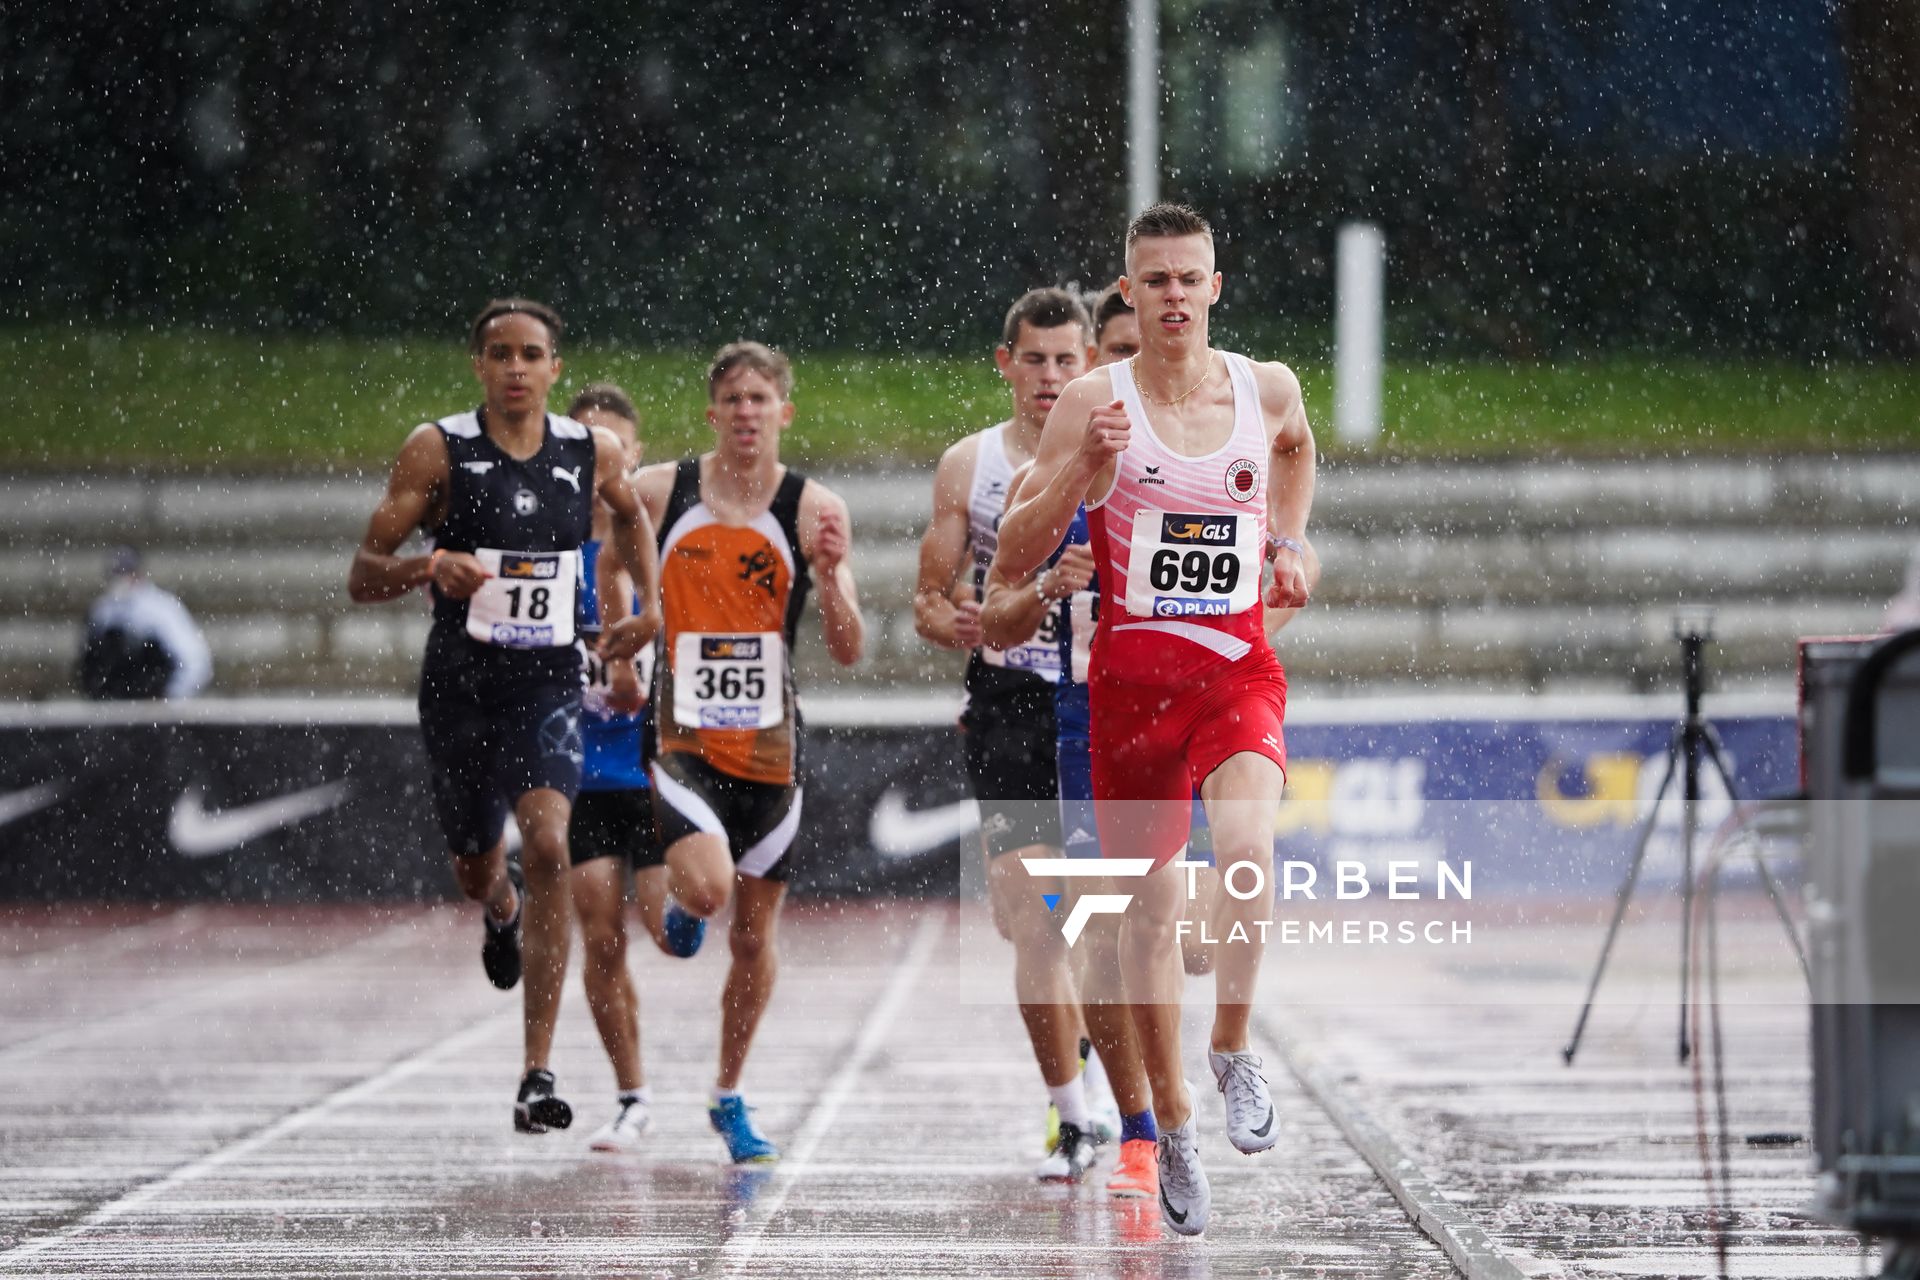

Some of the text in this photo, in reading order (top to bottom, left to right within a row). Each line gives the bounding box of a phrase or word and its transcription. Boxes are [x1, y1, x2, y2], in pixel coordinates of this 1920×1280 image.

[1229, 461, 1258, 477] DRESDNER
[1201, 524, 1231, 540] GLS
[1150, 549, 1240, 594] 699
[506, 586, 550, 620] 18
[1184, 602, 1227, 615] PLAN
[695, 667, 765, 700] 365
